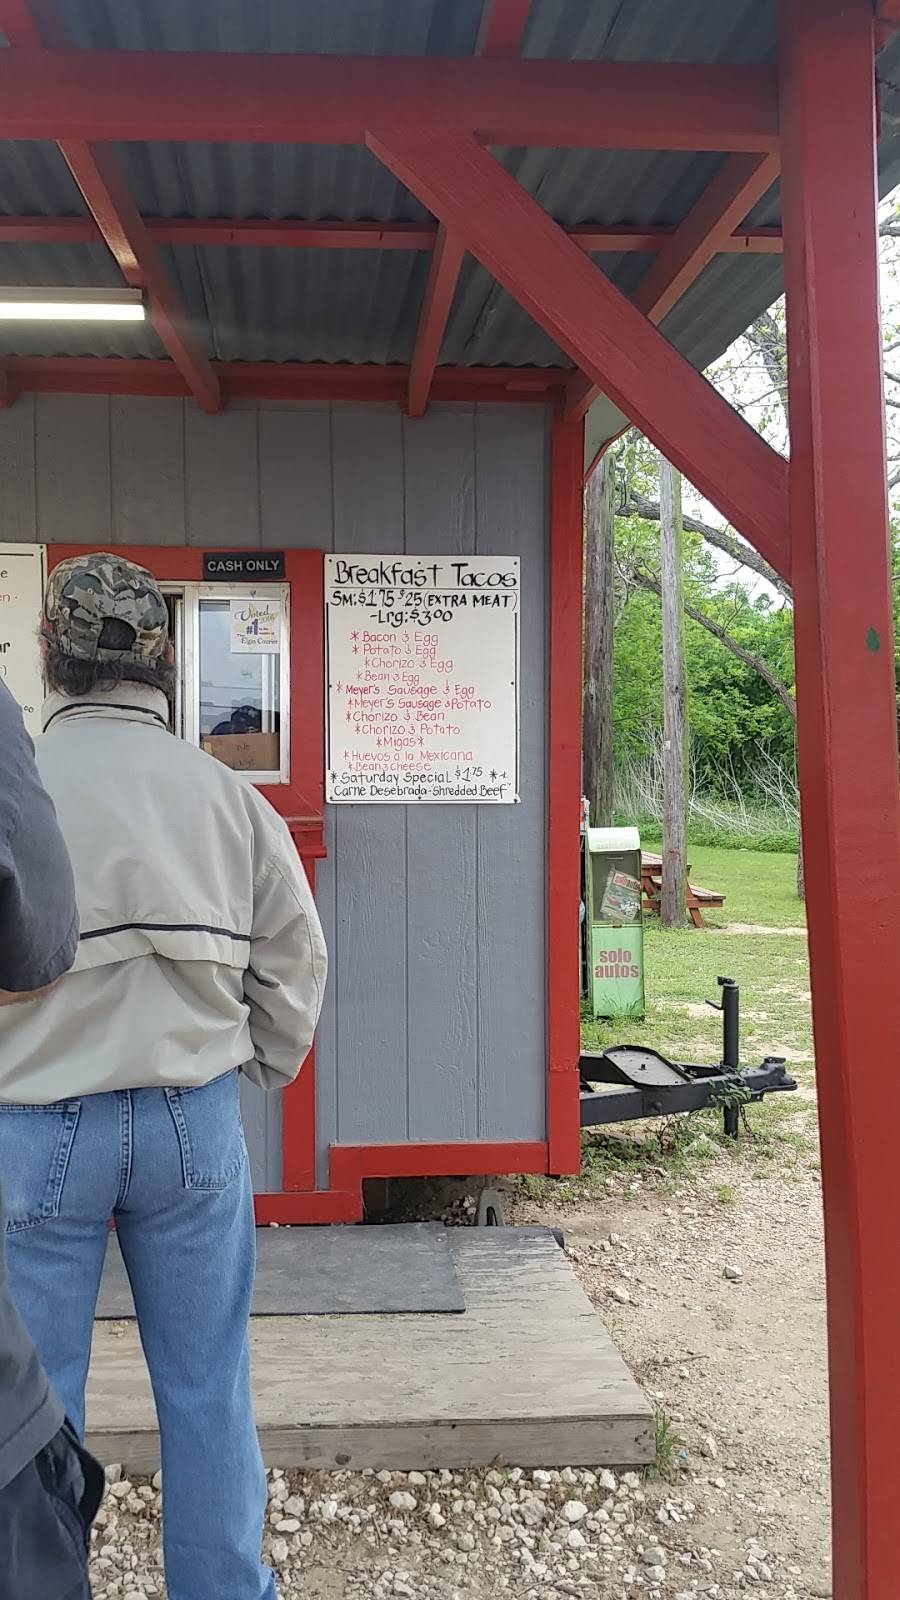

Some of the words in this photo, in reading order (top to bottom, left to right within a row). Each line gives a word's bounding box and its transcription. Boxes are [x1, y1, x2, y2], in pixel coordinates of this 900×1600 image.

[207, 560, 242, 571] CASH
[246, 560, 280, 571] ONLY
[334, 561, 443, 587] Breakfast
[451, 563, 517, 587] Tacos
[234, 604, 269, 621] Voted
[246, 619, 258, 636] #1
[362, 631, 396, 643] Bacon
[415, 632, 439, 646] Egg
[363, 643, 402, 655] Potato
[415, 645, 437, 659] Egg
[371, 657, 415, 669] Chorizo
[430, 659, 454, 672] Egg
[365, 670, 390, 681] Bean
[402, 673, 420, 686] Egg
[387, 684, 438, 699] Sausage
[454, 685, 475, 699] Egg
[398, 698, 442, 711] Sausage
[451, 698, 492, 711] Potato
[352, 710, 398, 722] Chorizo
[415, 710, 445, 722] Bean
[361, 723, 405, 735] Chorizo
[420, 723, 460, 735] Potato
[383, 736, 417, 751] Migas
[351, 751, 391, 762] Huevos
[394, 753, 400, 761] a
[404, 750, 414, 761] la
[420, 750, 473, 761] Mexicana
[340, 771, 399, 786] Saturday
[403, 771, 452, 785] Special
[334, 785, 366, 797] Carne
[599, 948, 632, 963] solo
[595, 963, 639, 978] autos
